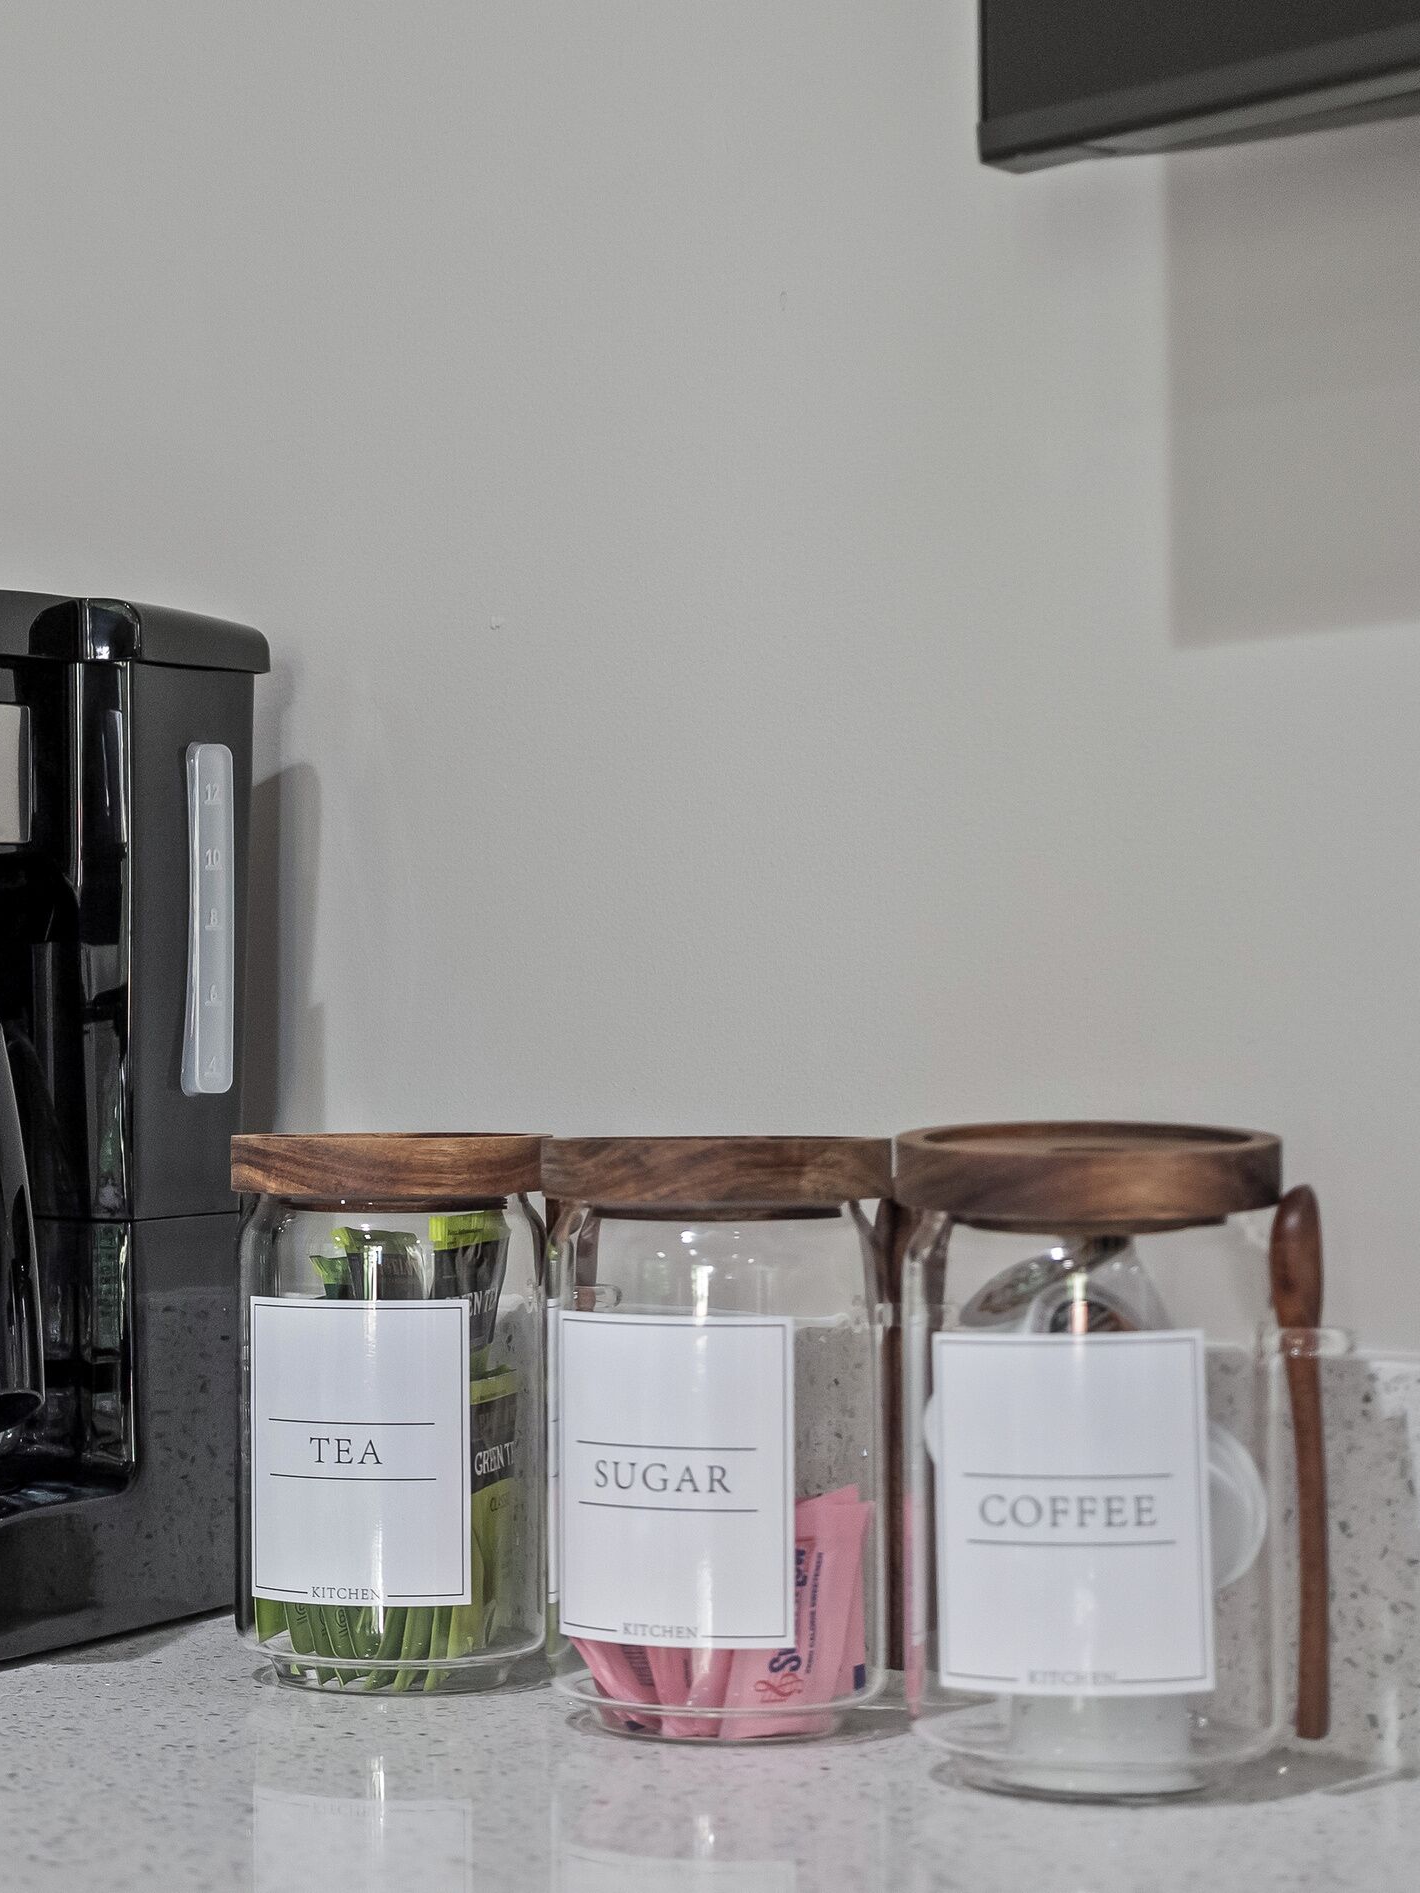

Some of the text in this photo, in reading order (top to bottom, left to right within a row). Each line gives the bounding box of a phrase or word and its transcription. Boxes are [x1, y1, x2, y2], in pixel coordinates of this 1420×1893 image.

[309, 1437, 383, 1465] TEA
[594, 1459, 731, 1493] SUGAR
[979, 1493, 1157, 1528] COFFEE
[312, 1586, 381, 1600] KITCHEN
[622, 1622, 698, 1639] KITCHEN
